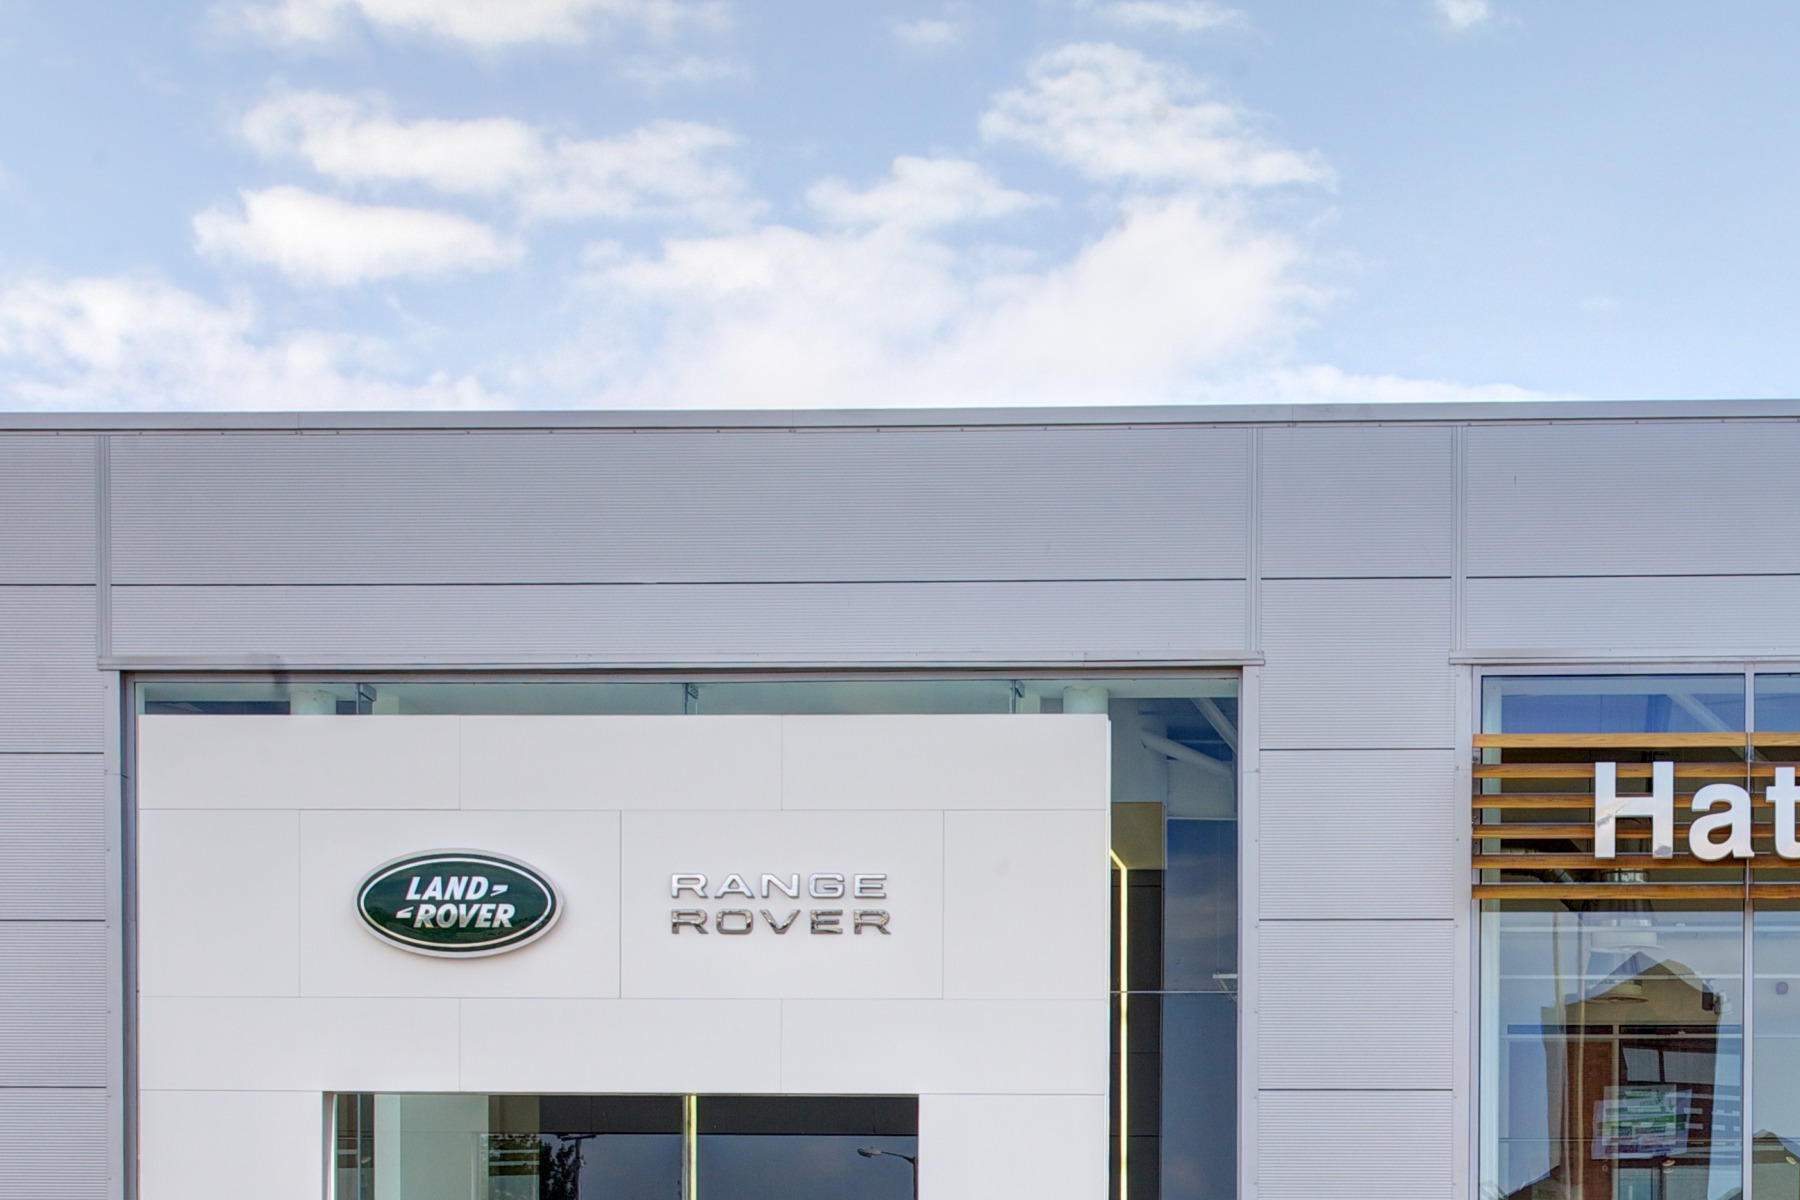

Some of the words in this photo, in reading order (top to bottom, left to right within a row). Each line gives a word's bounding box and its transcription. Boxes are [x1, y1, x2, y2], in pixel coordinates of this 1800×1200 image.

[405, 876, 489, 900] LAND
[670, 872, 888, 900] RANGE
[413, 902, 516, 929] ROVER
[670, 908, 892, 935] ROVER
